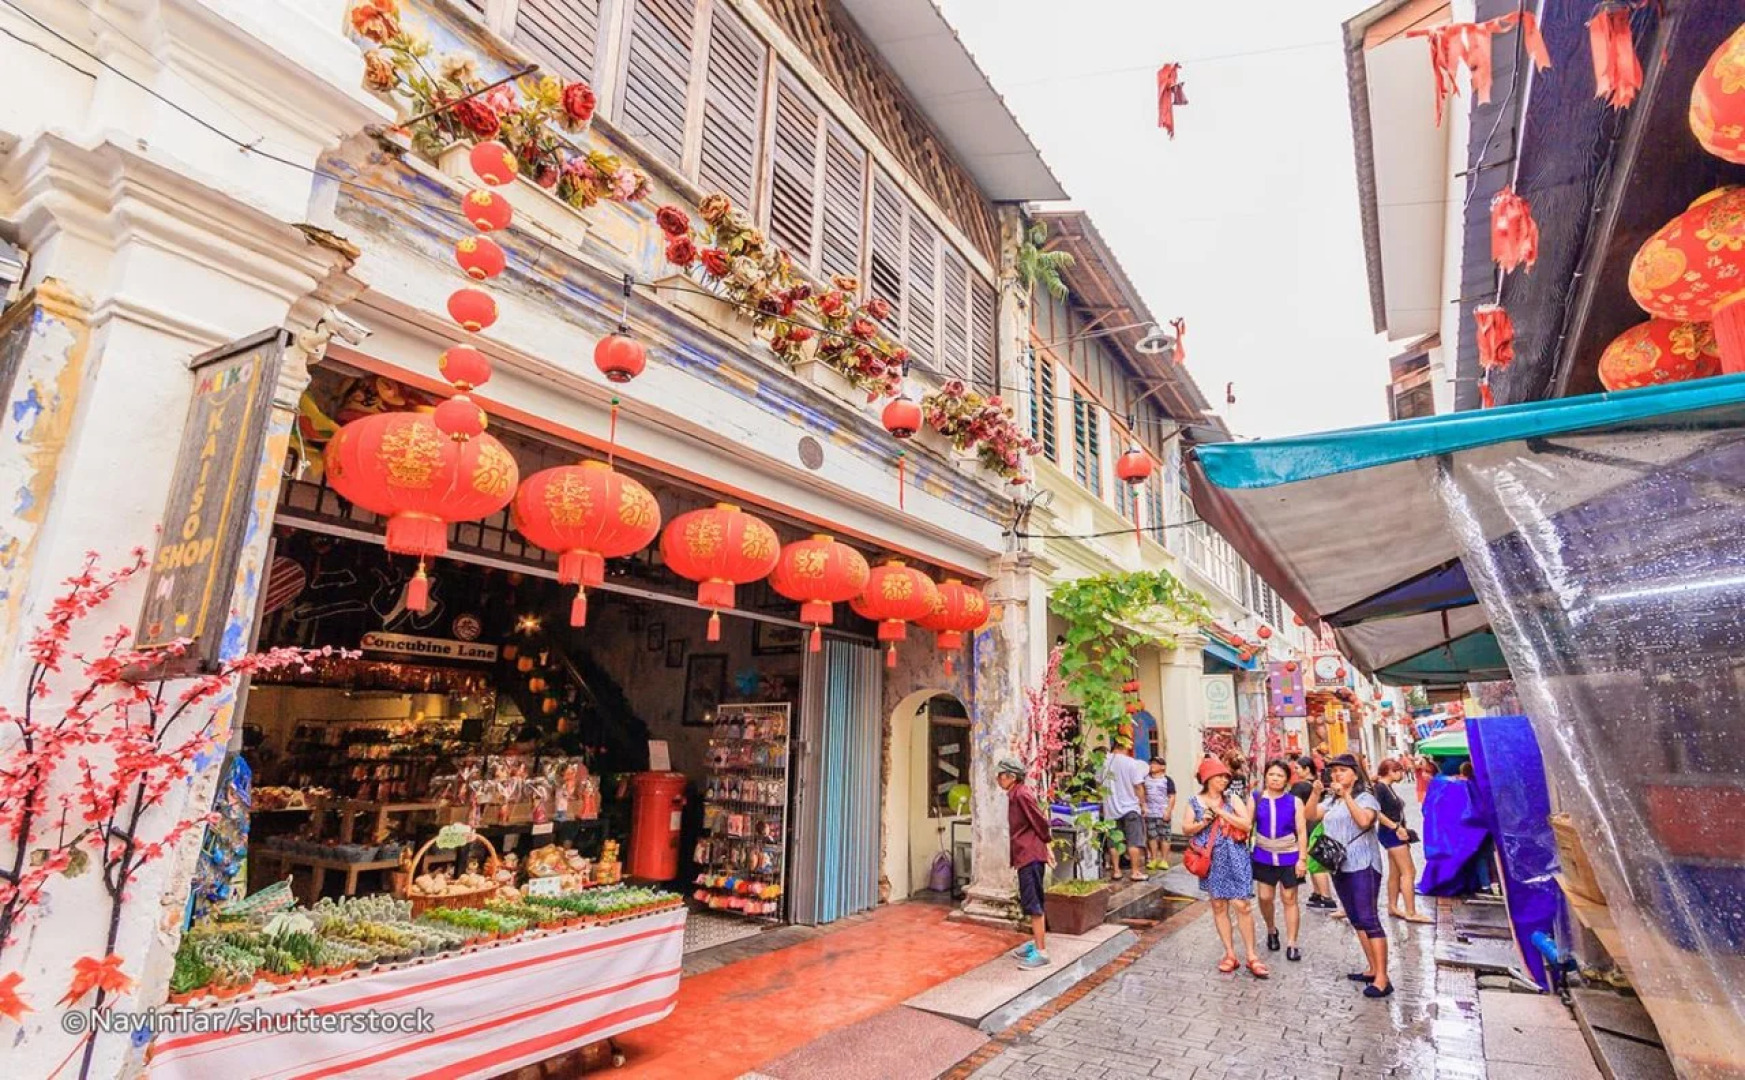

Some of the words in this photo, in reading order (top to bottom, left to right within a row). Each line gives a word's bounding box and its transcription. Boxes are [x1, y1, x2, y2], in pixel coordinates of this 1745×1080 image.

[154, 537, 214, 572] SHOP
[362, 633, 453, 655] Concubine
[457, 644, 496, 659] Lane
